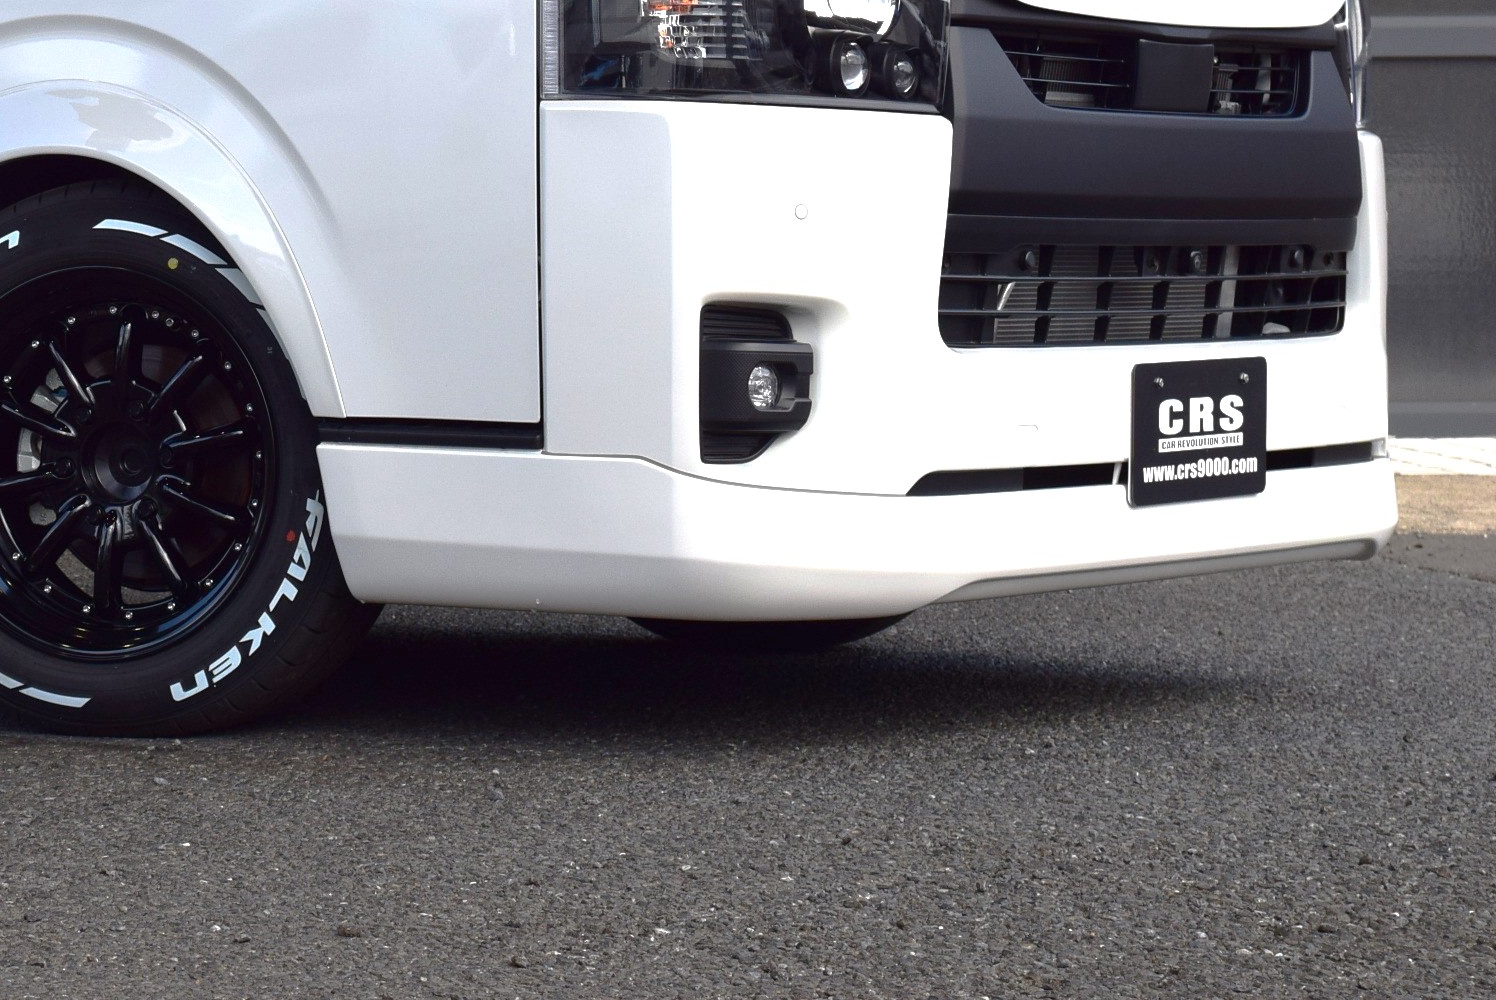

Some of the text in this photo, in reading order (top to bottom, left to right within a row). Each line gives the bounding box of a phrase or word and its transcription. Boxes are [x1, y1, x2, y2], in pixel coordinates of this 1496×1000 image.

[1158, 394, 1244, 435] CRS
[1162, 435, 1240, 449] CAR REVOLUTION STYLE
[1142, 456, 1258, 483] www.crs9000.com
[169, 488, 325, 702] FALKEN
